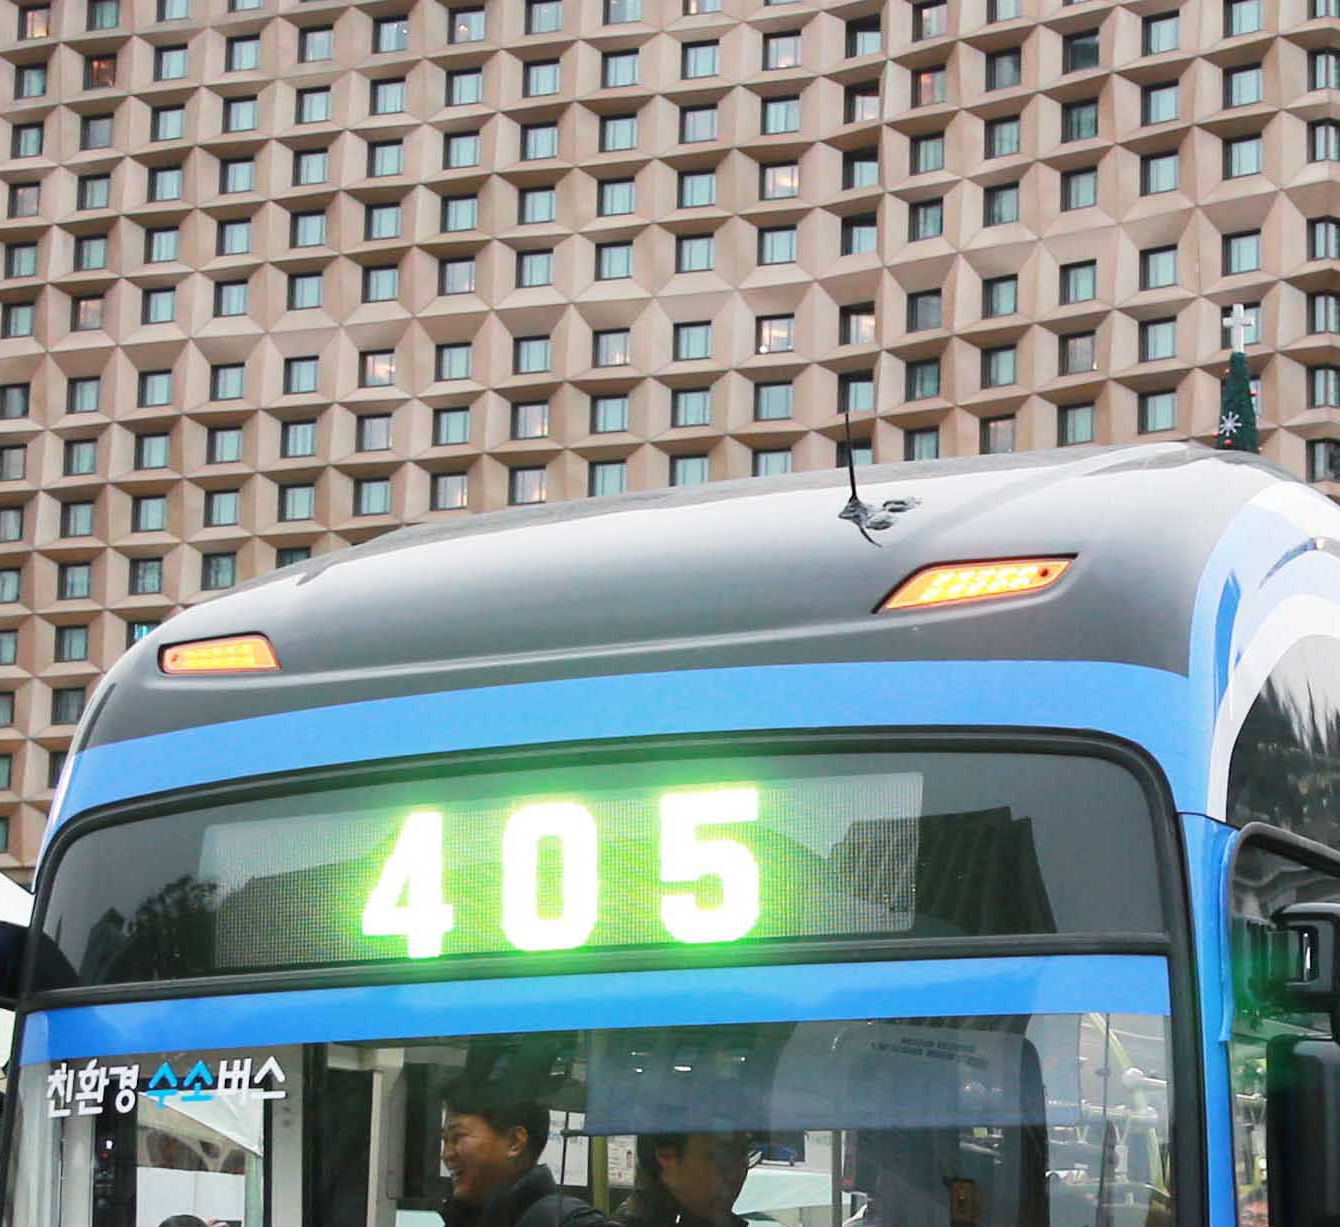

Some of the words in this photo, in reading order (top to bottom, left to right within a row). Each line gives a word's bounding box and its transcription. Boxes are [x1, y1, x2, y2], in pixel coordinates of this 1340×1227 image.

[362, 787, 760, 958] 405
[47, 1059, 140, 1118] 친환경
[147, 1055, 287, 1109] 수소버스
